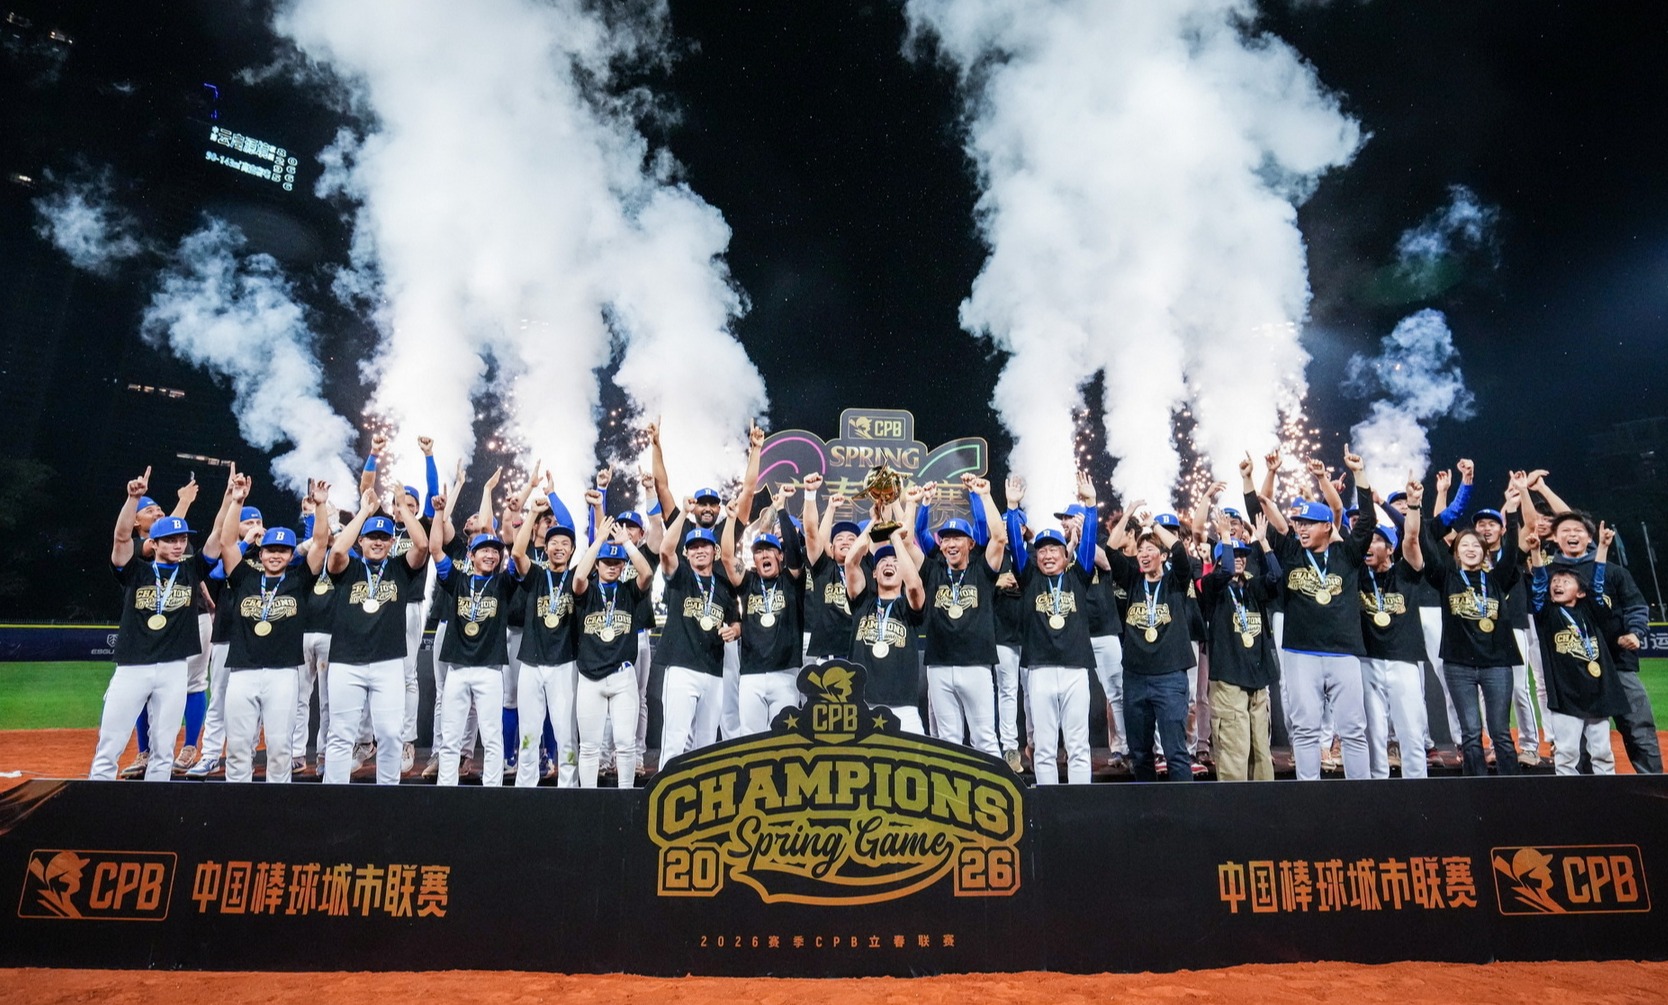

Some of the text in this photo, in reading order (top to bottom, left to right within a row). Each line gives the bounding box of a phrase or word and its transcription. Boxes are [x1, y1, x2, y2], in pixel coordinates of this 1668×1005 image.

[874, 420, 902, 437] CPB
[829, 445, 920, 470] SPRING
[813, 703, 858, 732] CPB
[662, 760, 1009, 842] CHAMPIONS
[665, 850, 1013, 889] 20 26
[728, 816, 952, 878] Spring Game
[88, 862, 165, 911] CPB
[192, 860, 450, 917] 中国棒球城市联赛
[1218, 856, 1478, 914] 中国棒球城市联赛
[1561, 855, 1639, 904] CPB
